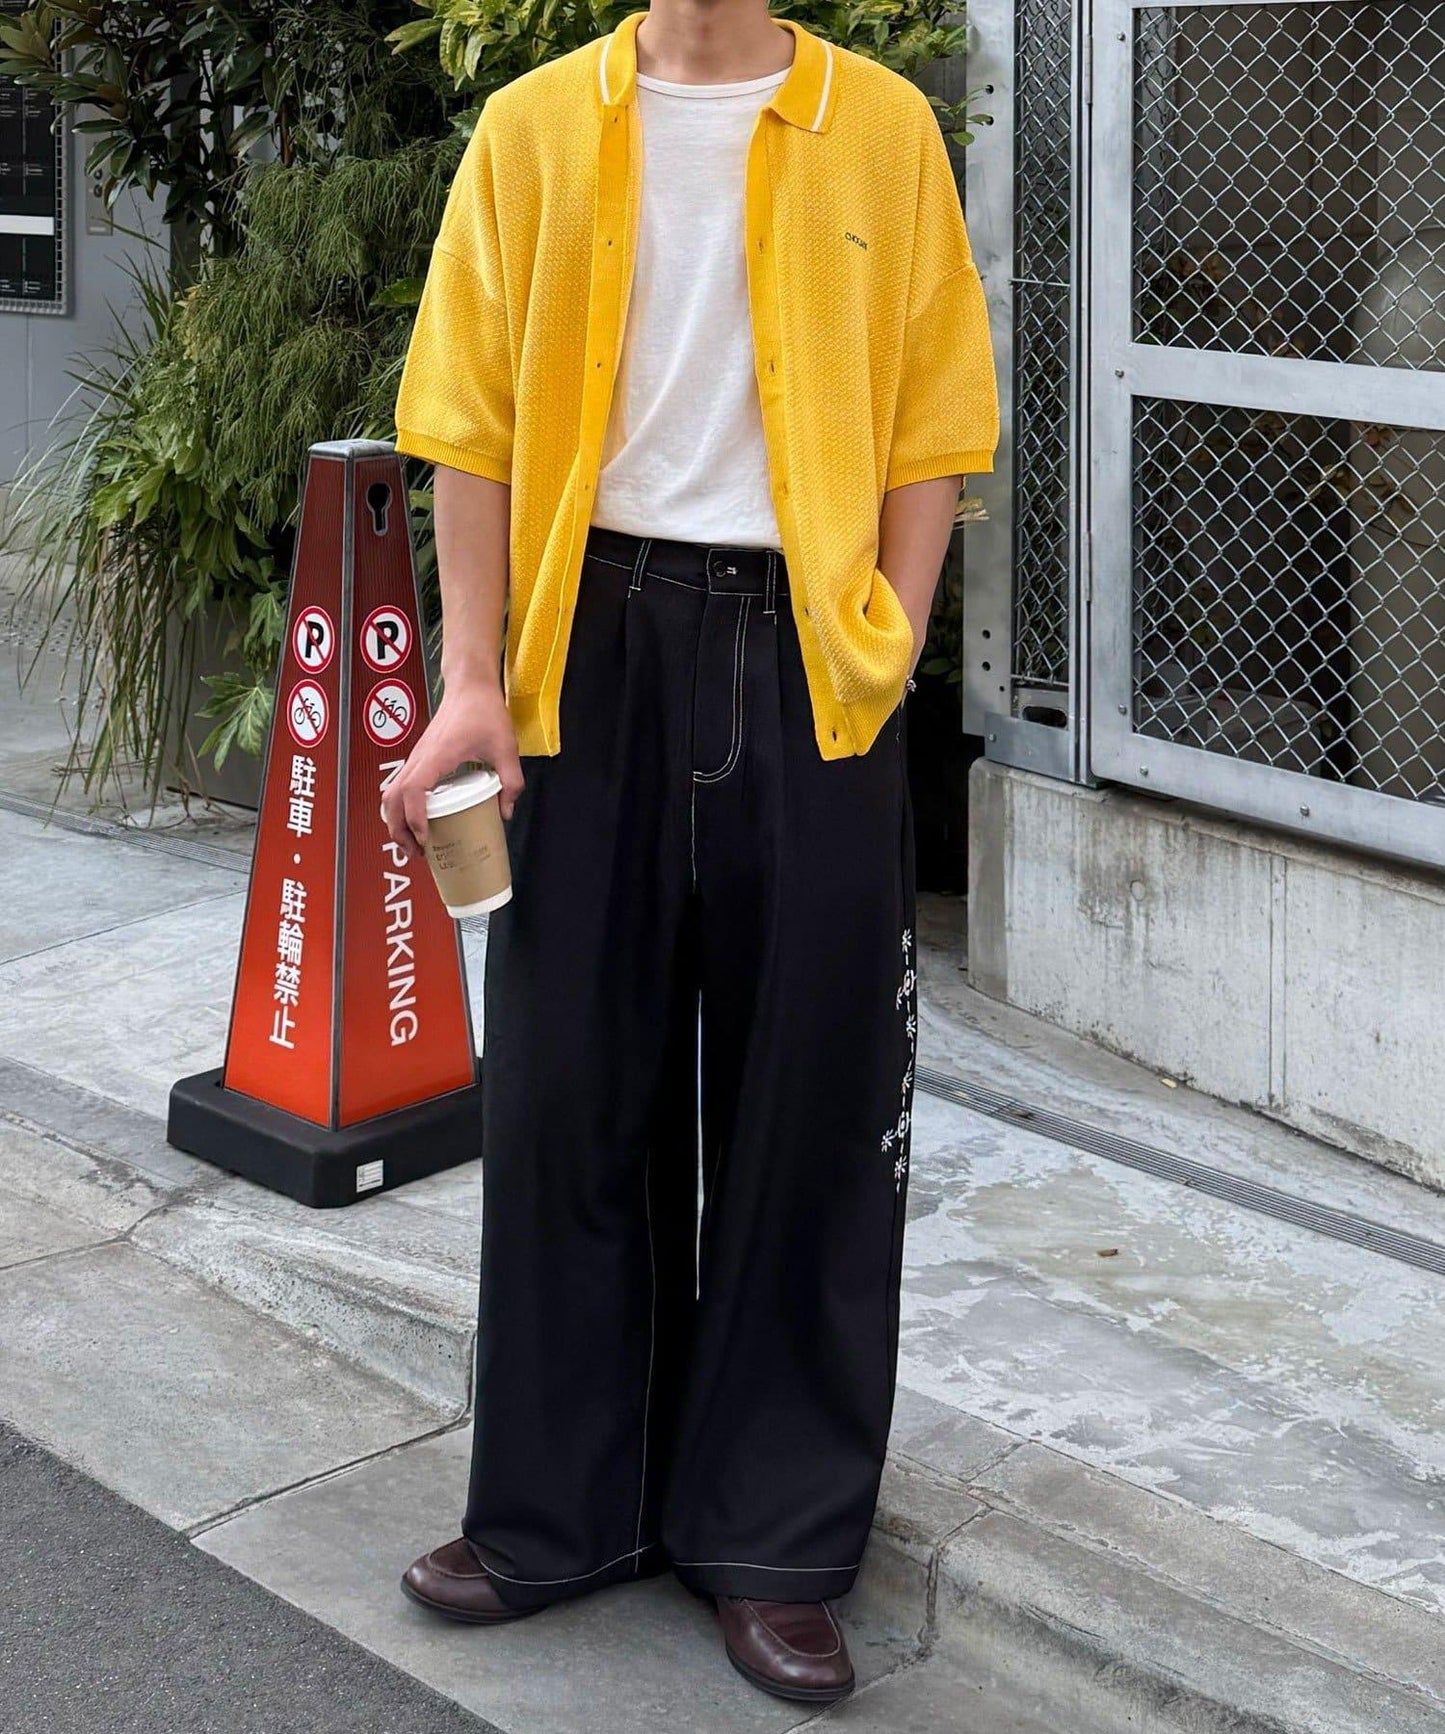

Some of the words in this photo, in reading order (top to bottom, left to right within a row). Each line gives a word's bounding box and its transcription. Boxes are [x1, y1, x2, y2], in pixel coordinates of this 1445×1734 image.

[305, 621, 325, 658] P
[376, 620, 399, 660] P
[379, 759, 406, 824] N
[269, 754, 317, 1050] 駐車・駐輪禁止
[382, 841, 419, 1047] PARKING
